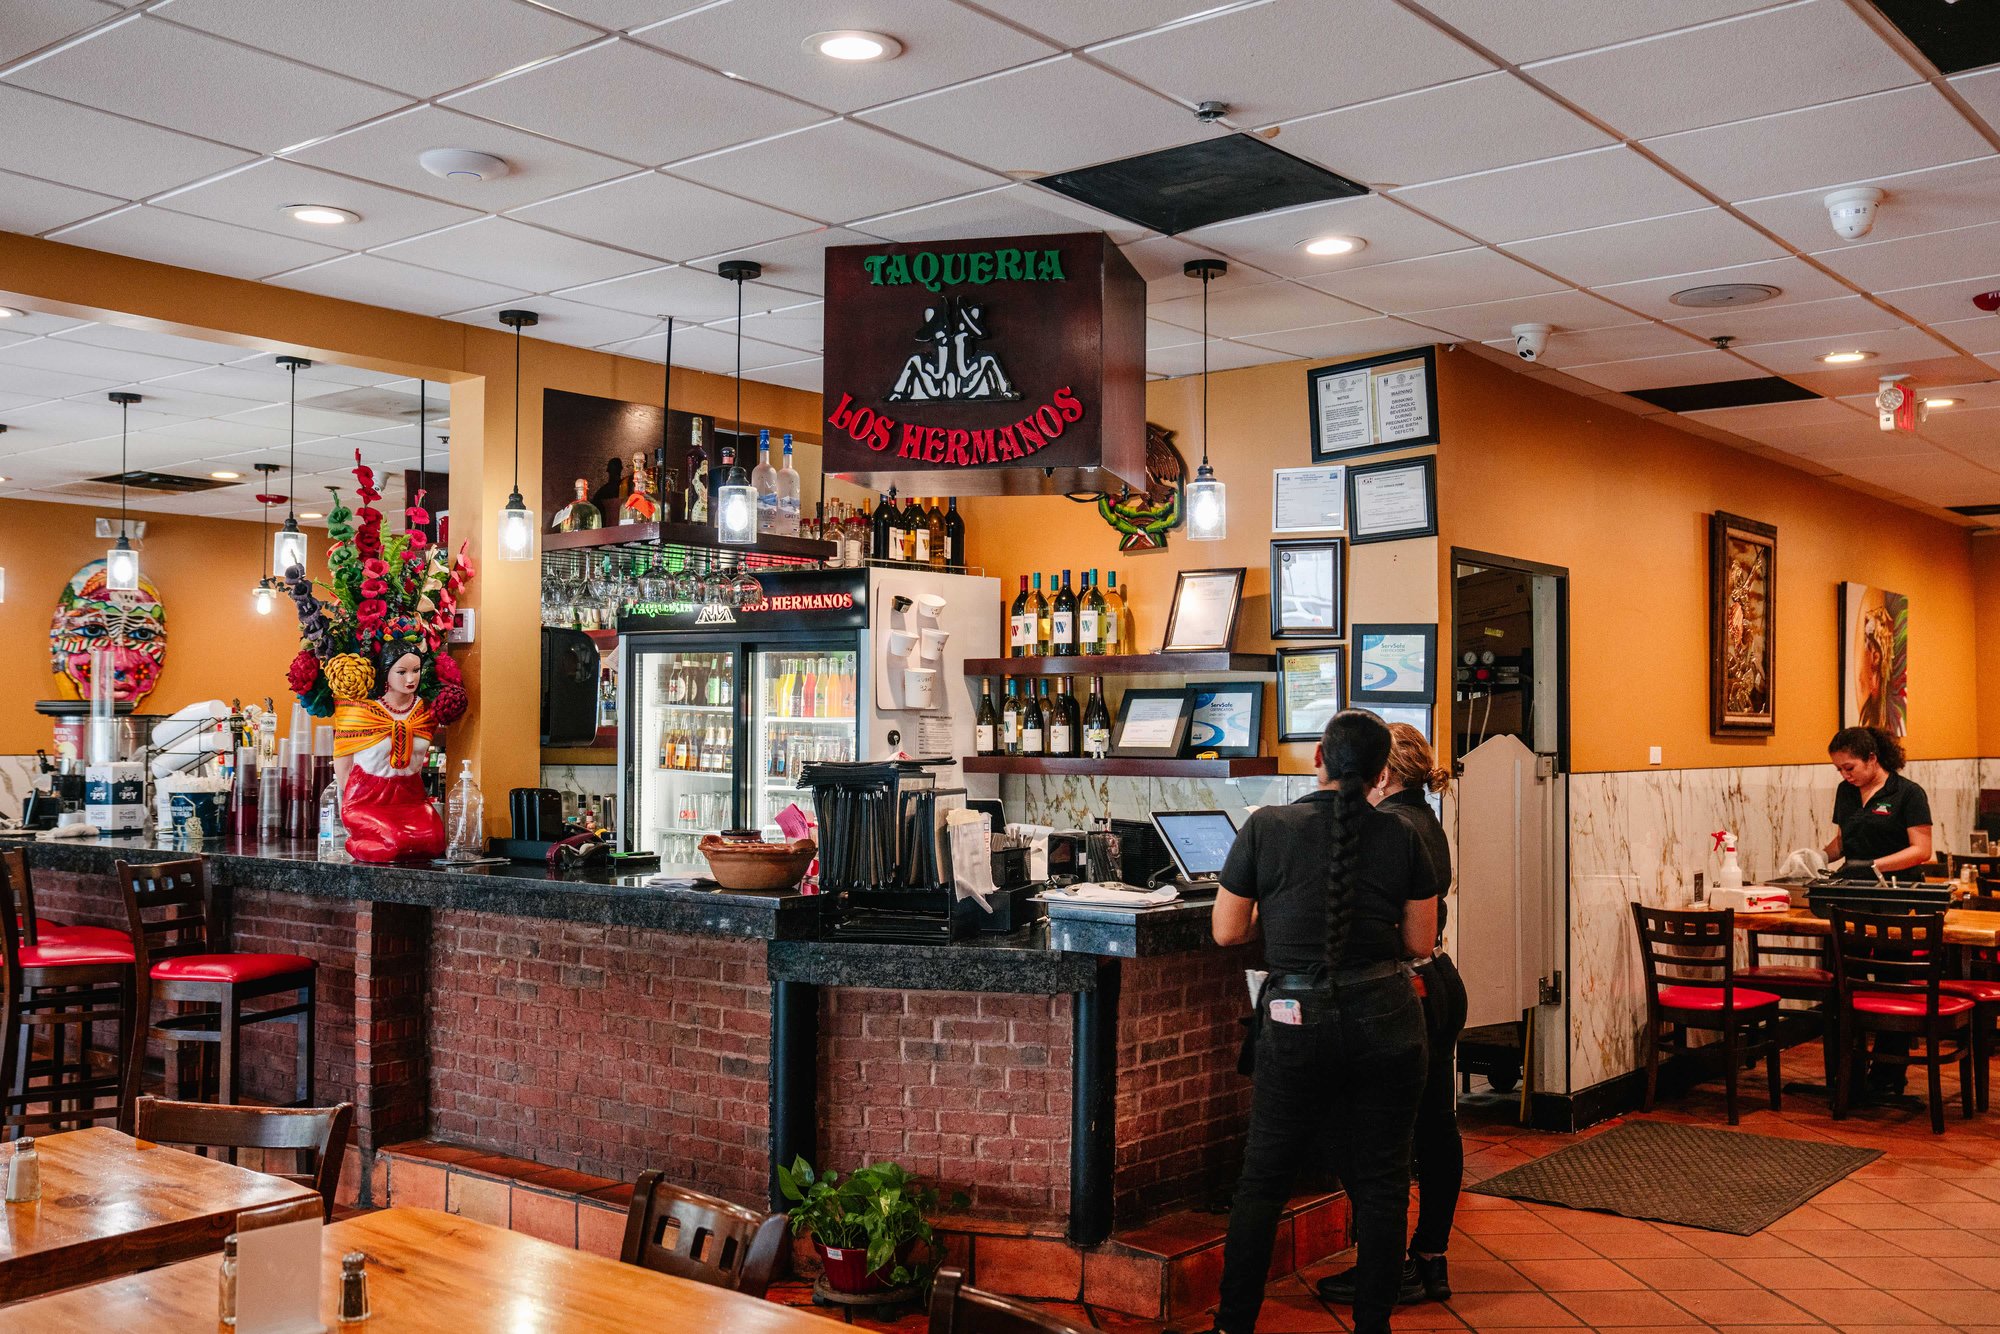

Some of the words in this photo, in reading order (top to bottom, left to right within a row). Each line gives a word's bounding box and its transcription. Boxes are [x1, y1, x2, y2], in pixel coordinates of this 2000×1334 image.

[864, 248, 1065, 292] TAQUERIA
[828, 392, 895, 451] LOS
[897, 386, 1083, 466] HERMANOS
[771, 592, 853, 611] HERMANOS
[1381, 641, 1406, 649] ServSafe
